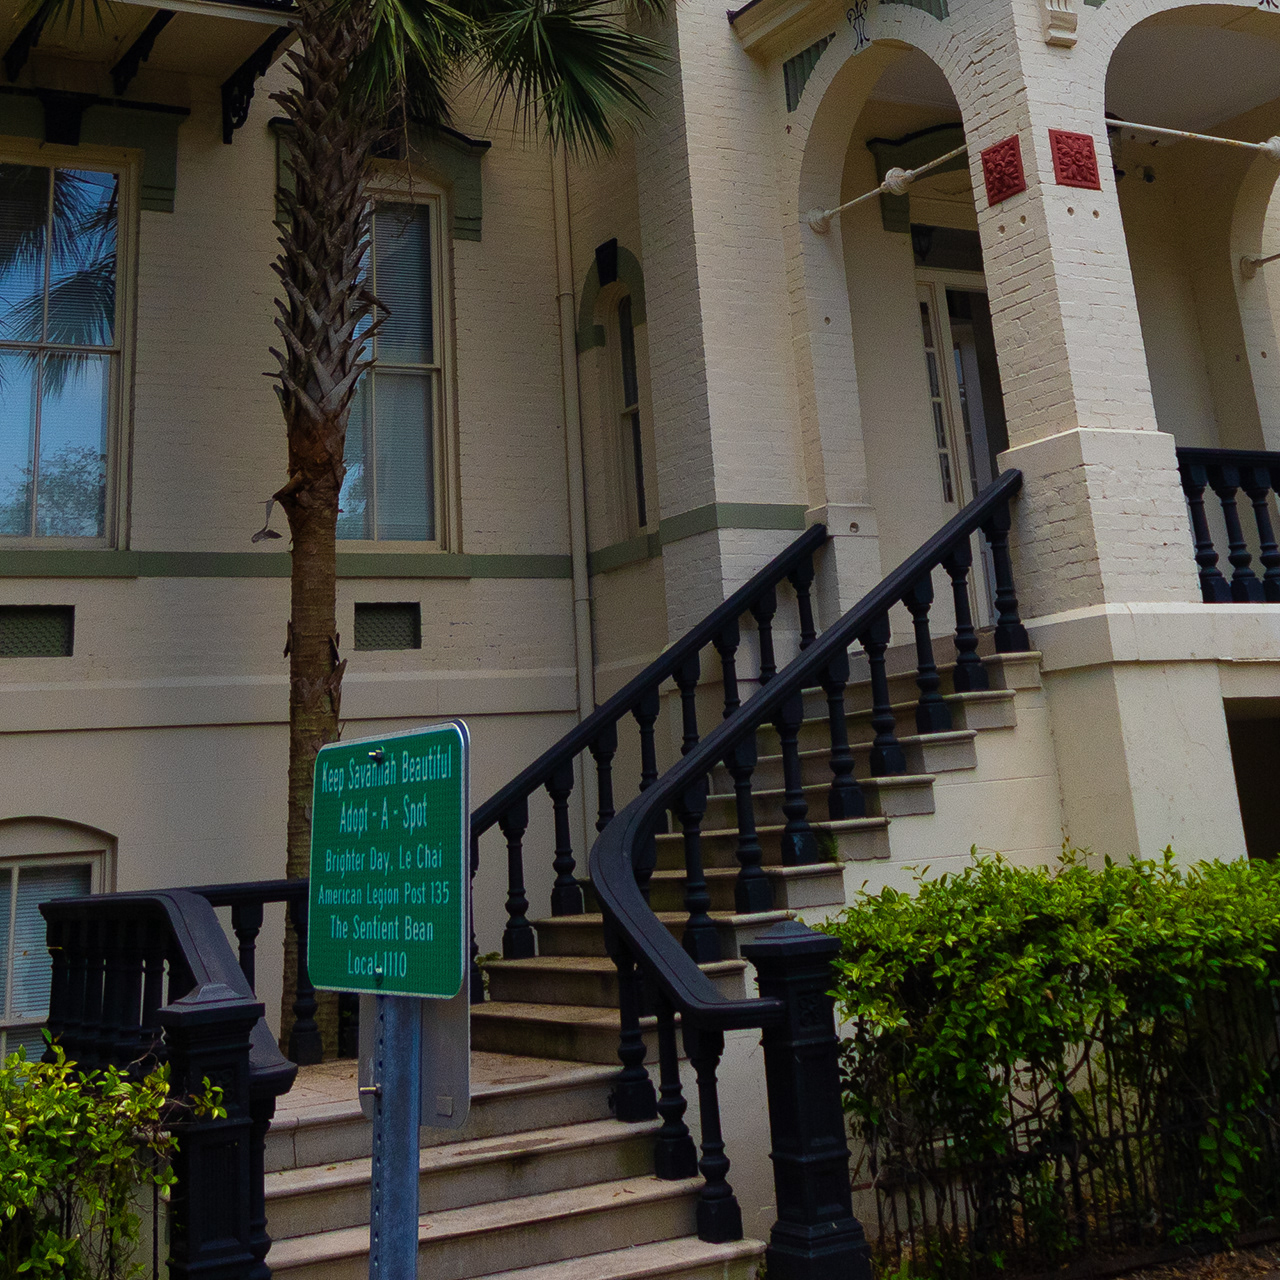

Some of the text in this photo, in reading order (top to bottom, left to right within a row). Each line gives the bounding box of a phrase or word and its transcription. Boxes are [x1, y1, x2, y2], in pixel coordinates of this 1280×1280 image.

[322, 744, 452, 798] Keep Savannah Beautiful
[339, 799, 368, 839] Adopt
[403, 793, 428, 836] Spot
[325, 848, 365, 879] Brighter
[400, 845, 412, 870] Le
[417, 842, 442, 869] Chai
[318, 881, 450, 911] American Legion Post 135
[330, 914, 433, 941] The Sentient Bean
[383, 950, 407, 977] 1110
